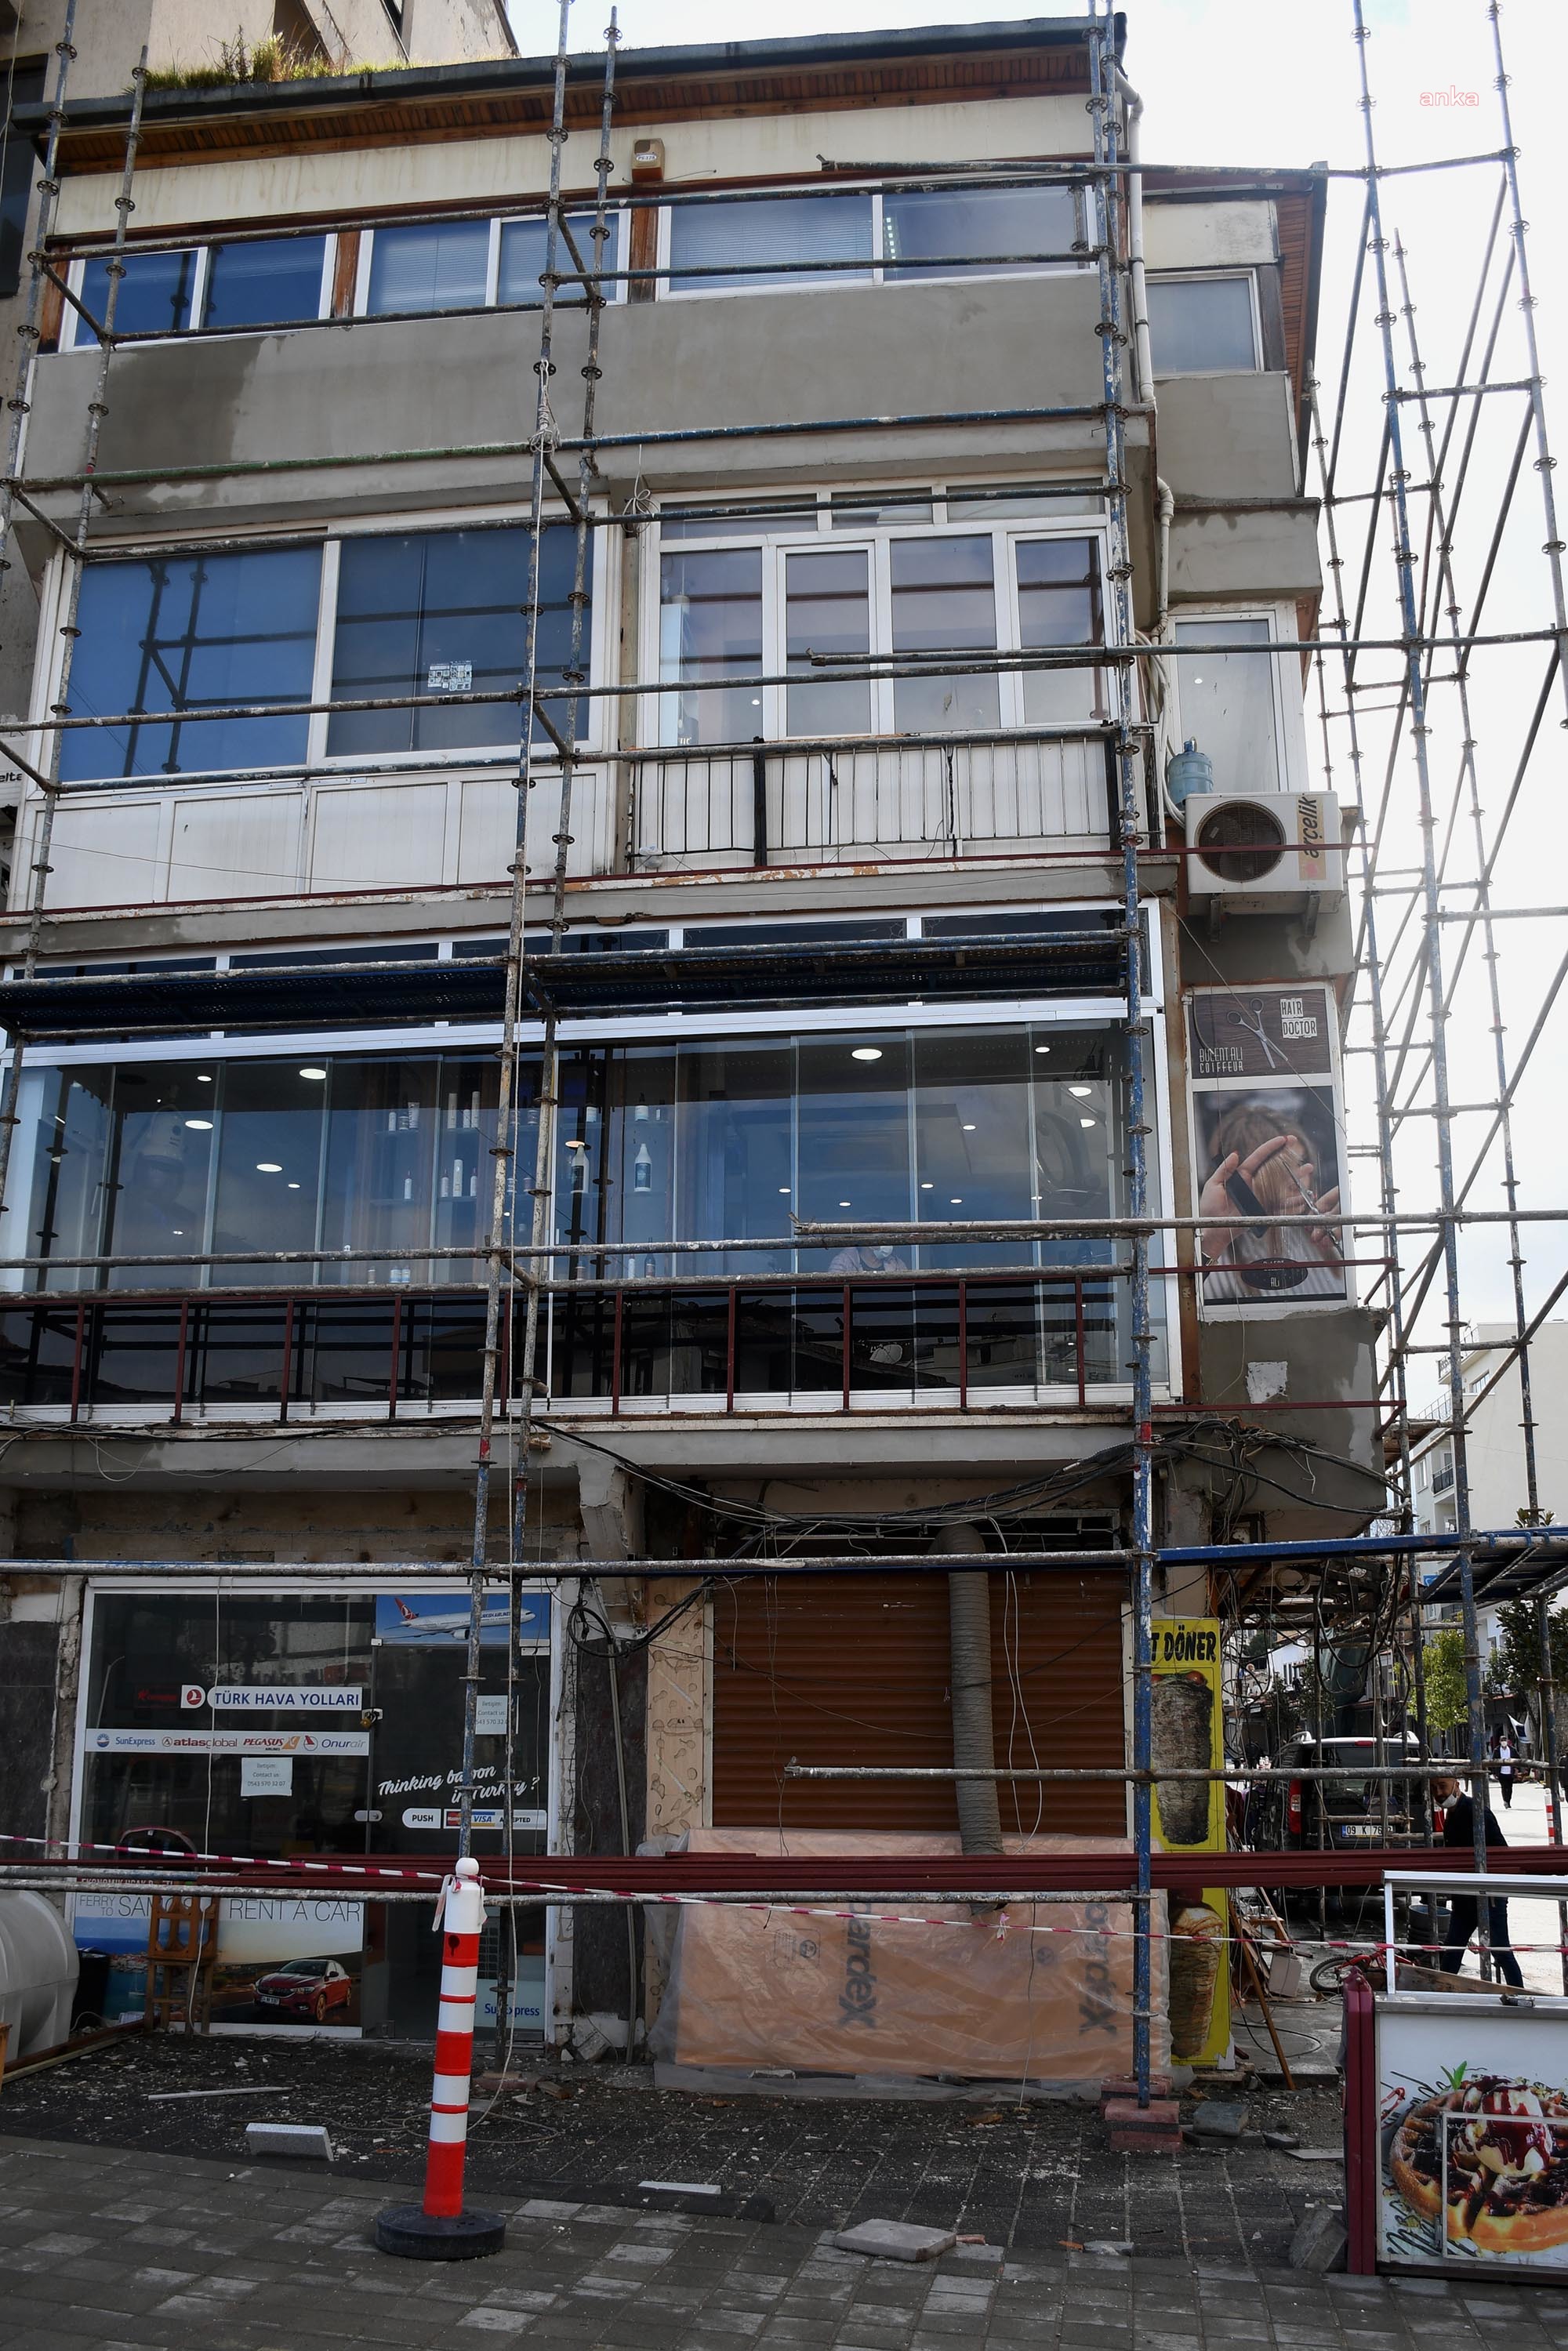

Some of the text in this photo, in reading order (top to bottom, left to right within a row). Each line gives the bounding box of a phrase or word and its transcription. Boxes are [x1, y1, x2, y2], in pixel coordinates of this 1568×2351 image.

[1298, 796, 1323, 859] arçelik
[1281, 1000, 1303, 1016] HAIR
[1283, 1020, 1317, 1036] DOCTOR
[1200, 1061, 1244, 1074] COIFFEUR
[1151, 1624, 1217, 1663] T DÖNER
[215, 1689, 360, 1707] TÜRK HAVA YOLLARI
[115, 1736, 156, 1747] SunExpress
[173, 1737, 238, 1750] atlasglobal
[243, 1738, 285, 1747] PEGASUS
[321, 1739, 367, 1748] Onurair
[378, 1774, 445, 1796] Thinking
[412, 1814, 434, 1823] PUSH
[1346, 1826, 1356, 1835] 09
[1362, 1826, 1367, 1835] K
[80, 1894, 115, 1917] FERRY TO
[229, 1898, 361, 1922] RENT A CAR
